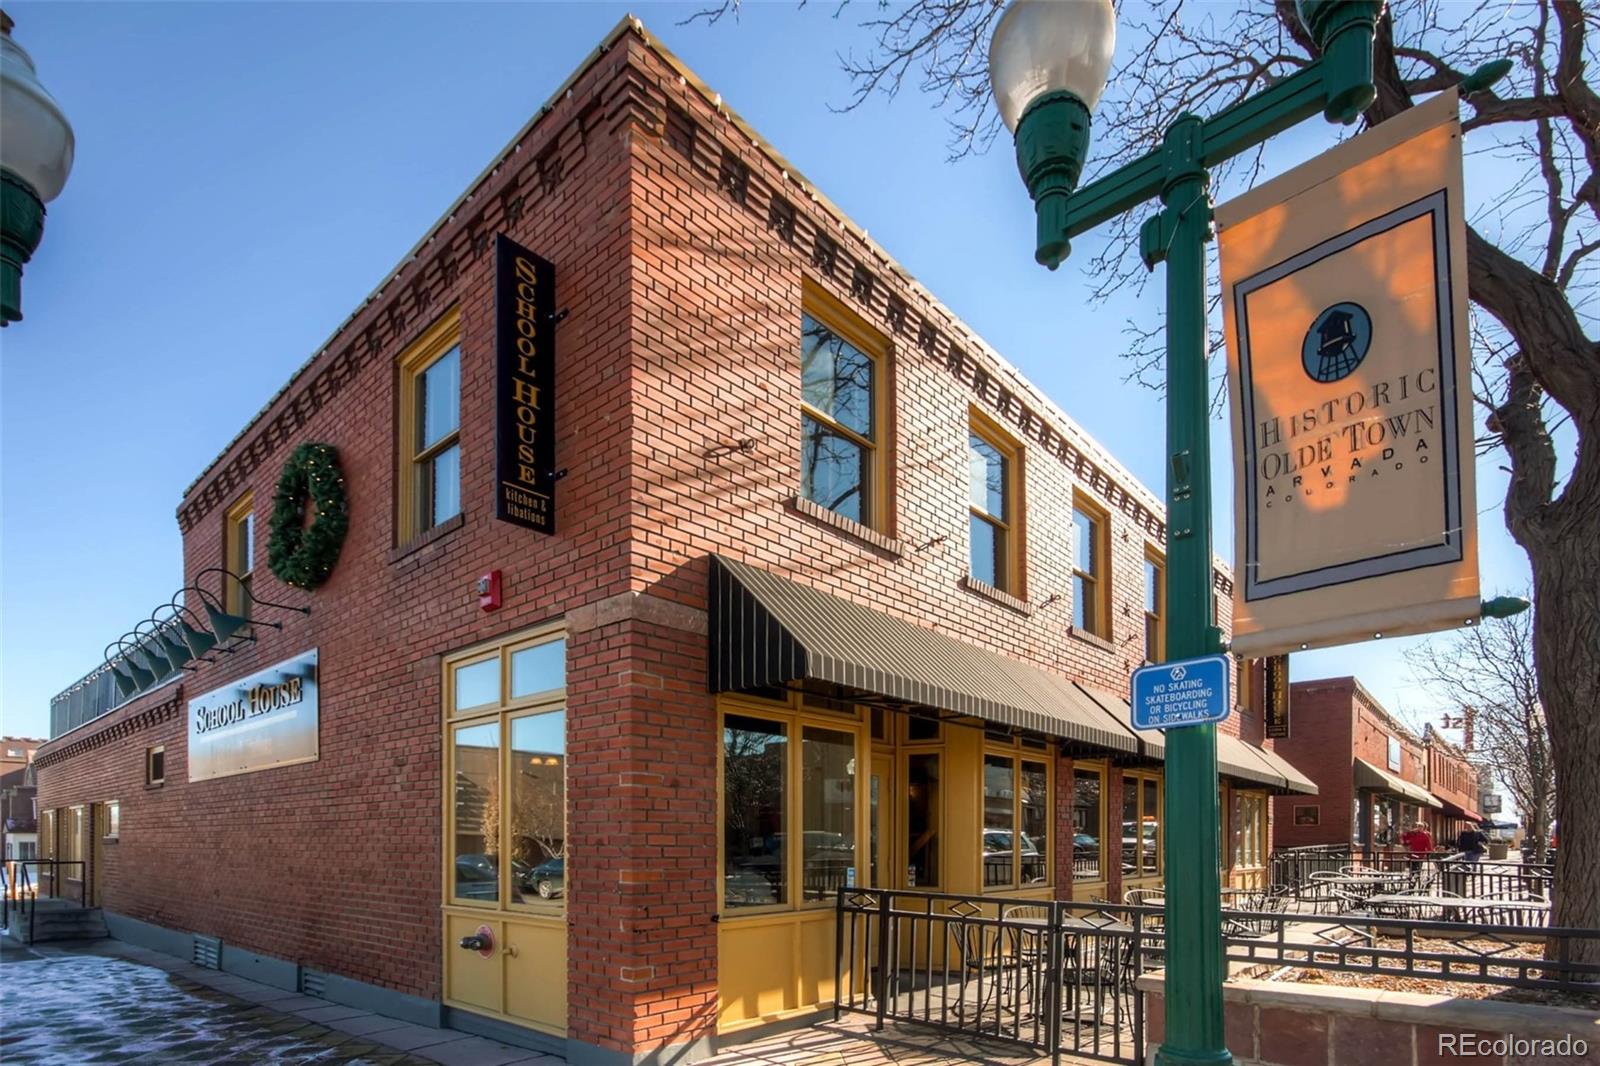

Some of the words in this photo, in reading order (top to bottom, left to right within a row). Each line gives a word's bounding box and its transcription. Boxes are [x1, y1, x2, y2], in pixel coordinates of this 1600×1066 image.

[515, 256, 537, 378] SCHOOL
[511, 376, 541, 485] HOUSE
[1259, 368, 1436, 450] HISTORIC
[1260, 437, 1333, 481] OLDE
[1341, 406, 1435, 454] TOWN
[1265, 438, 1428, 498] ARVADA
[505, 487, 538, 509] kitchen
[541, 499, 547, 512] &
[1265, 455, 1429, 509] COLORADO
[507, 502, 545, 526] libations
[196, 699, 246, 735] SCHOOL
[247, 677, 304, 718] HOUSE
[1145, 688, 1213, 705] SKATEBOARDING
[1149, 704, 1161, 714] OR
[1164, 699, 1208, 713] BICYCLING
[1153, 684, 1165, 694] NO
[1168, 678, 1203, 692] SKATING
[1148, 715, 1161, 725] ON
